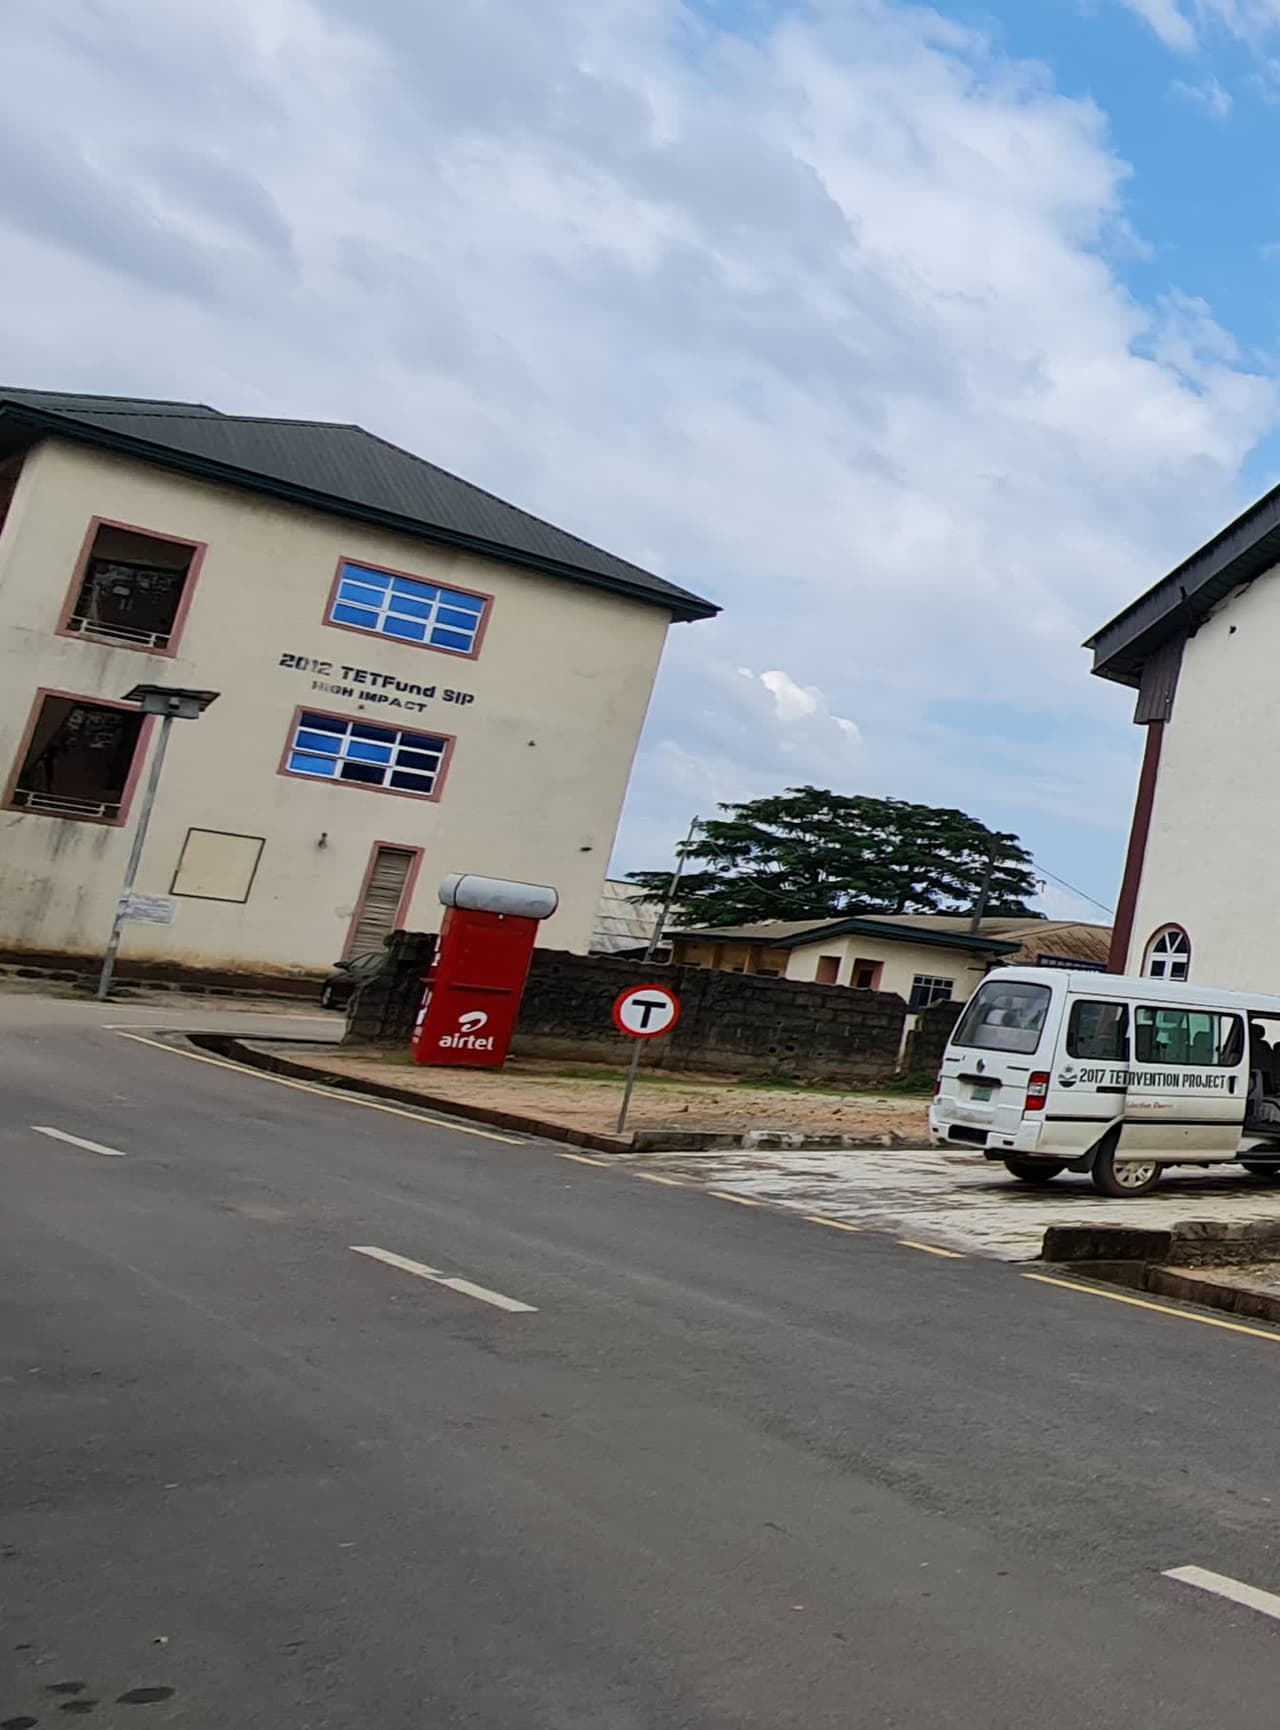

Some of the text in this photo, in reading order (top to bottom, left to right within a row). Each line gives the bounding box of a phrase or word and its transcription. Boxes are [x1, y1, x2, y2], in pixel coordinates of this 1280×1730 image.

[279, 653, 475, 706] 2012 TETFund SIP
[312, 681, 428, 713] HIGH IMPACT
[631, 999, 667, 1029] T
[438, 1032, 494, 1051] airtel
[1079, 1068, 1106, 1084] 2017
[1182, 1073, 1226, 1089] PROJECT
